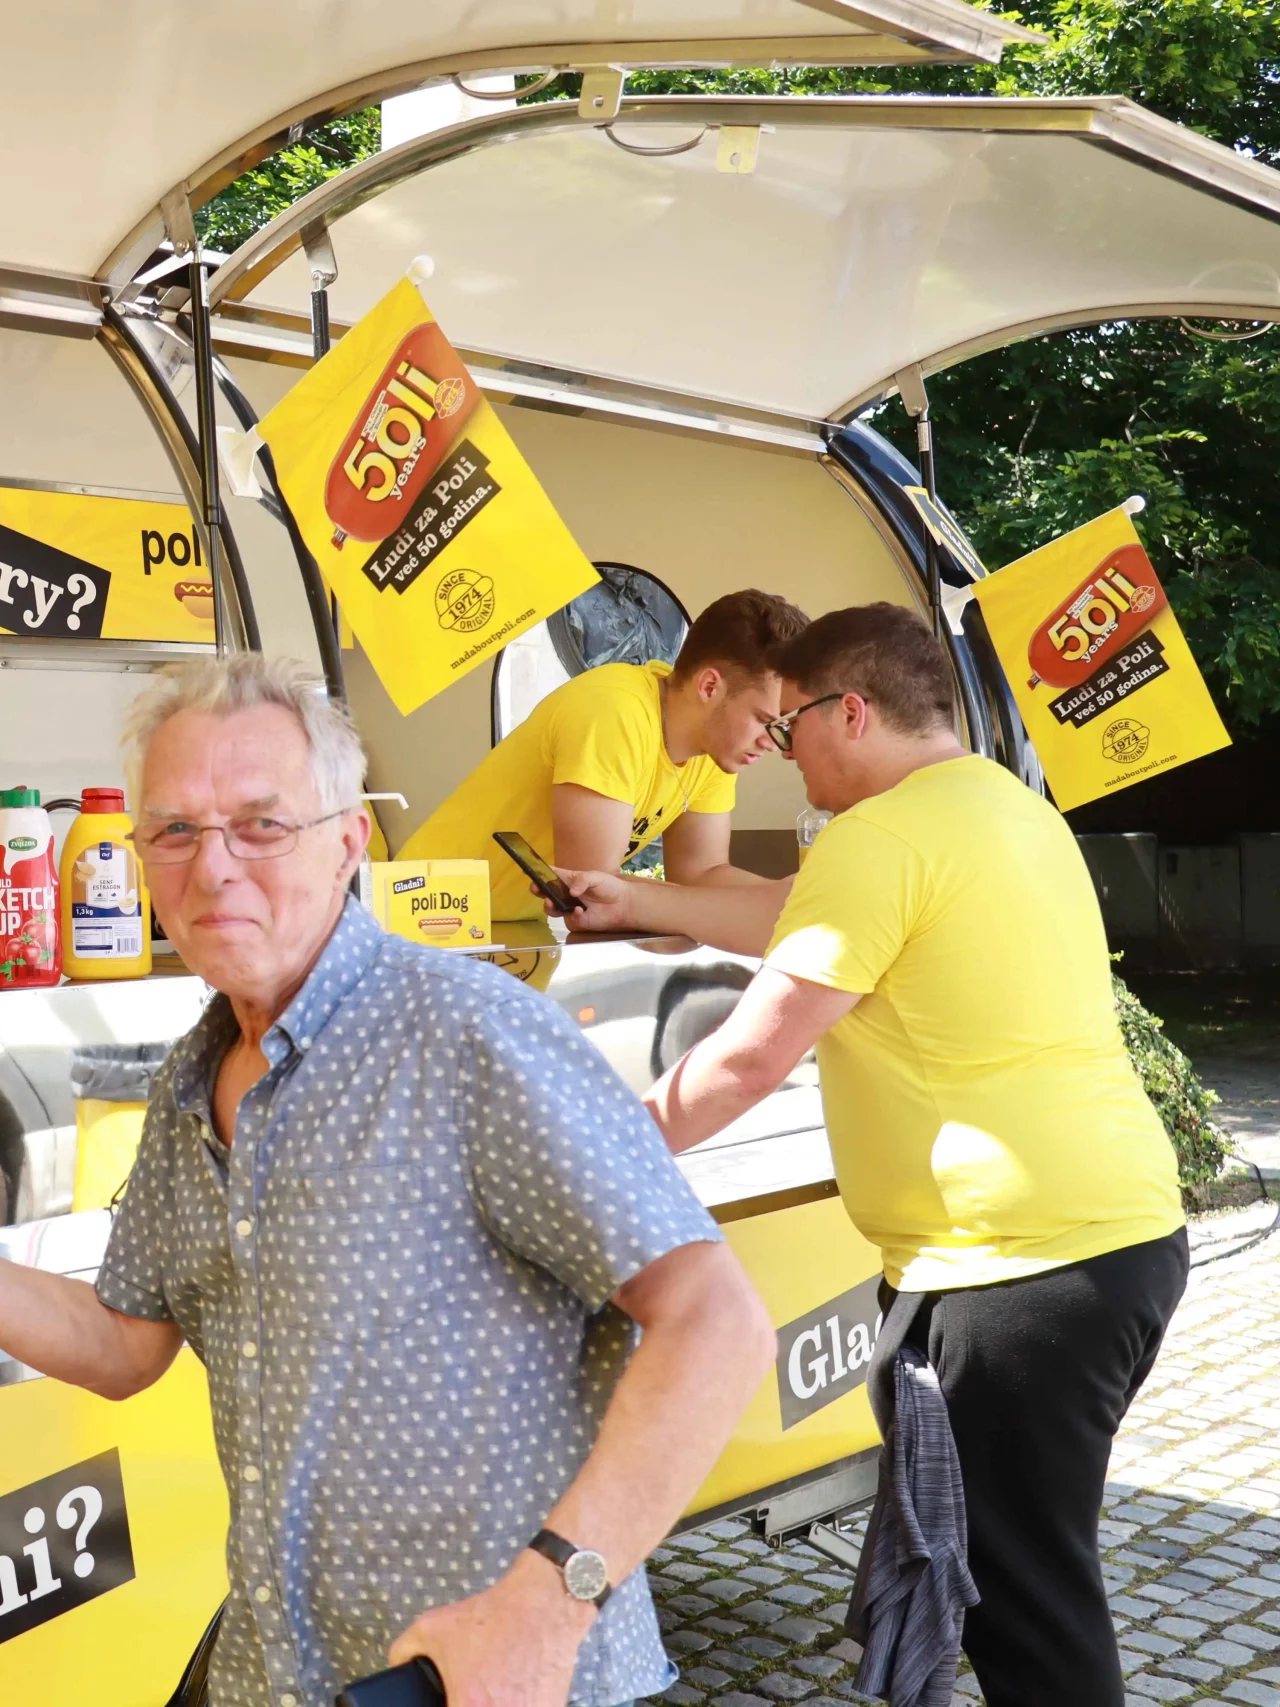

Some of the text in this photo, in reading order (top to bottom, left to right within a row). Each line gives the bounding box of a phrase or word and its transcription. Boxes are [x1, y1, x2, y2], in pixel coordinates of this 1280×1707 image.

[389, 436, 427, 500] years
[370, 528, 416, 581] Ludi
[414, 506, 438, 532] za
[432, 457, 477, 505] Poli
[395, 485, 493, 581] već 50 godina.
[141, 523, 209, 576] pol
[439, 573, 465, 600] SINCE
[448, 587, 482, 620] 1974
[460, 597, 492, 630] ORIGINAL
[450, 608, 536, 669] madaboutpoli.com
[1081, 622, 1118, 663] years
[1055, 641, 1154, 717] Ludi za Poli
[1075, 664, 1163, 720] već 50 godina.
[1107, 721, 1130, 738] SINCE
[1112, 733, 1140, 753] 1974
[1118, 741, 1146, 761] ORIGINAL
[1104, 754, 1178, 787] madaboutpoli.com
[394, 878, 424, 892] Gladni?
[412, 892, 469, 915] poli Dog
[788, 1312, 883, 1399] Gla
